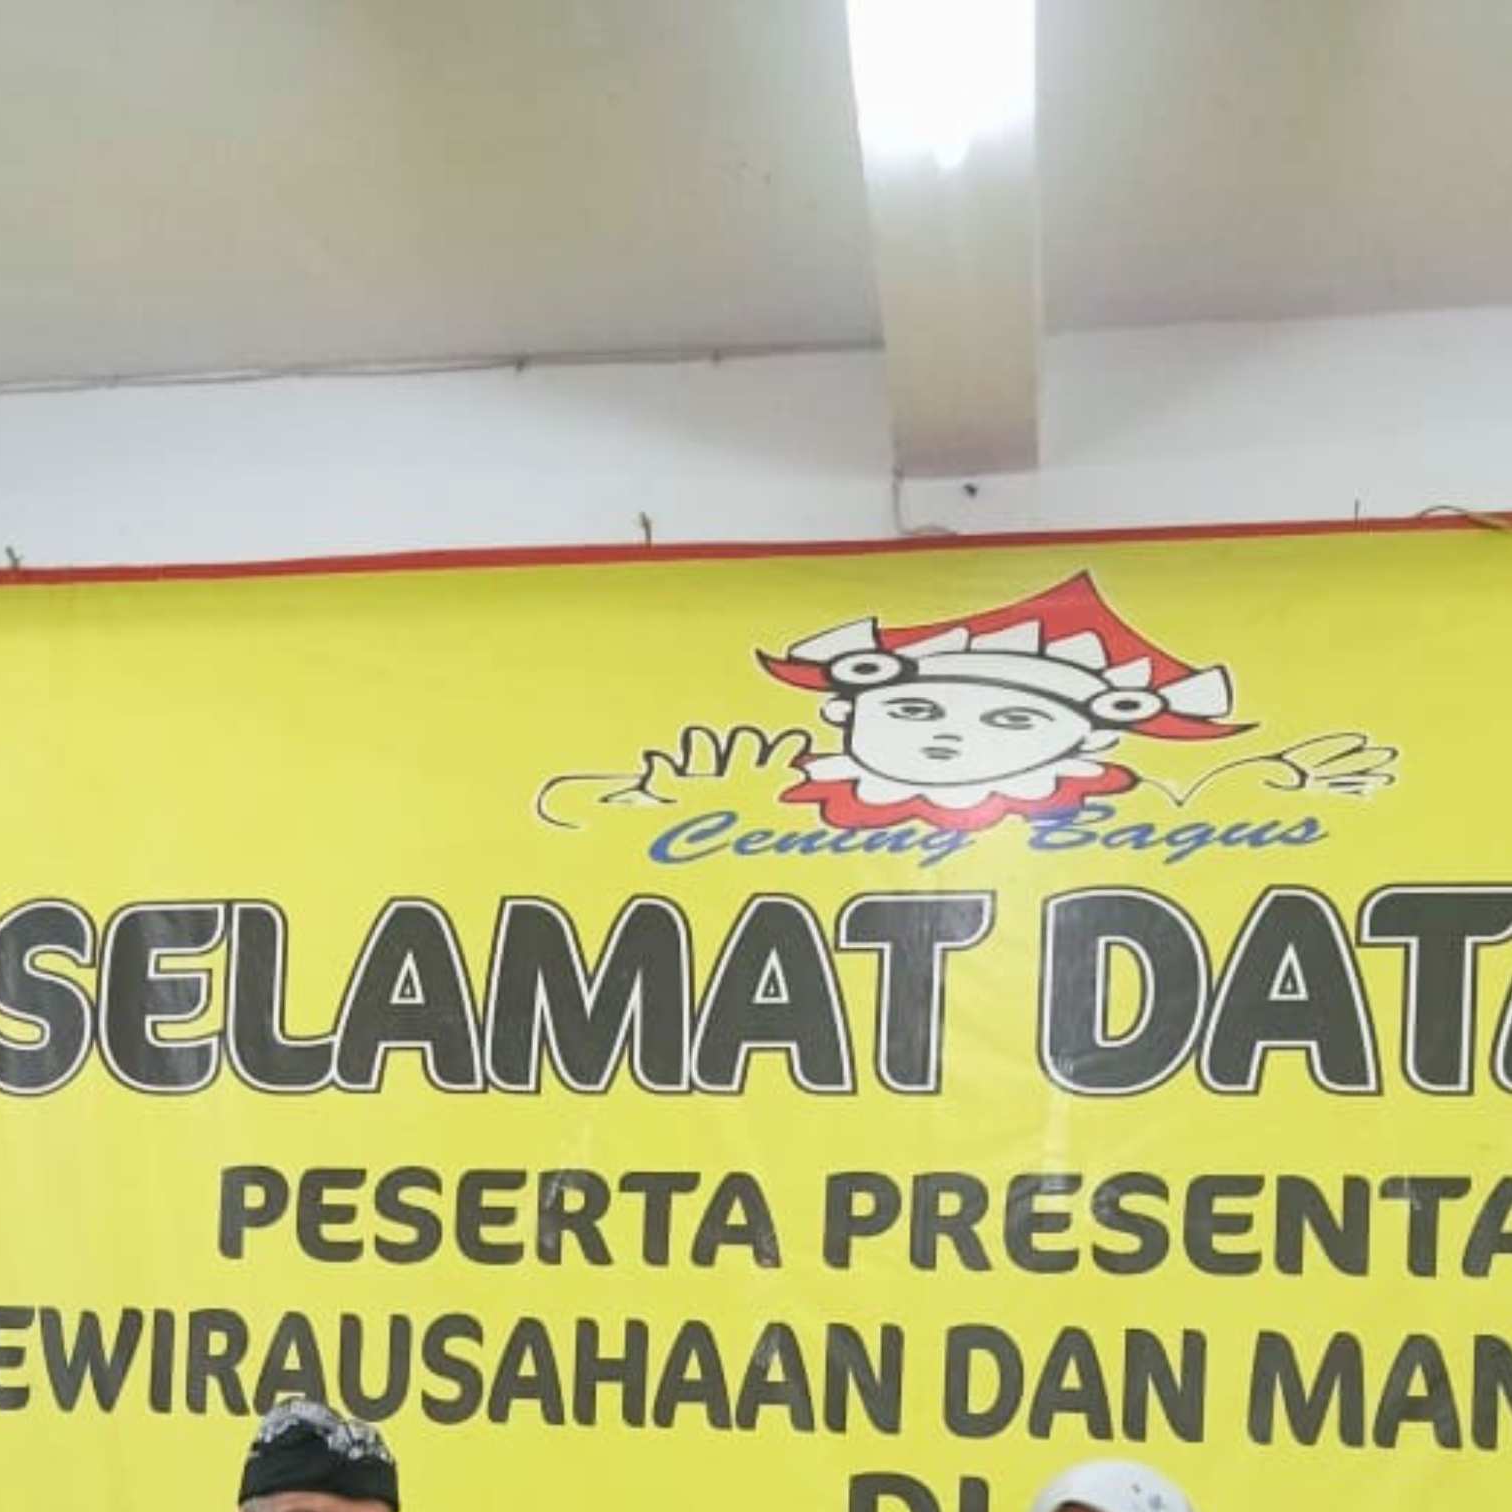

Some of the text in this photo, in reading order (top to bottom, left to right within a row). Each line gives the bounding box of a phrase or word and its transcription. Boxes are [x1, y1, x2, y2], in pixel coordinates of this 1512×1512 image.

[649, 803, 1329, 868] Cening Bagus
[1038, 881, 1512, 1096] DAT
[218, 1165, 783, 1269] PESERTA
[943, 1323, 1207, 1443] DAN
